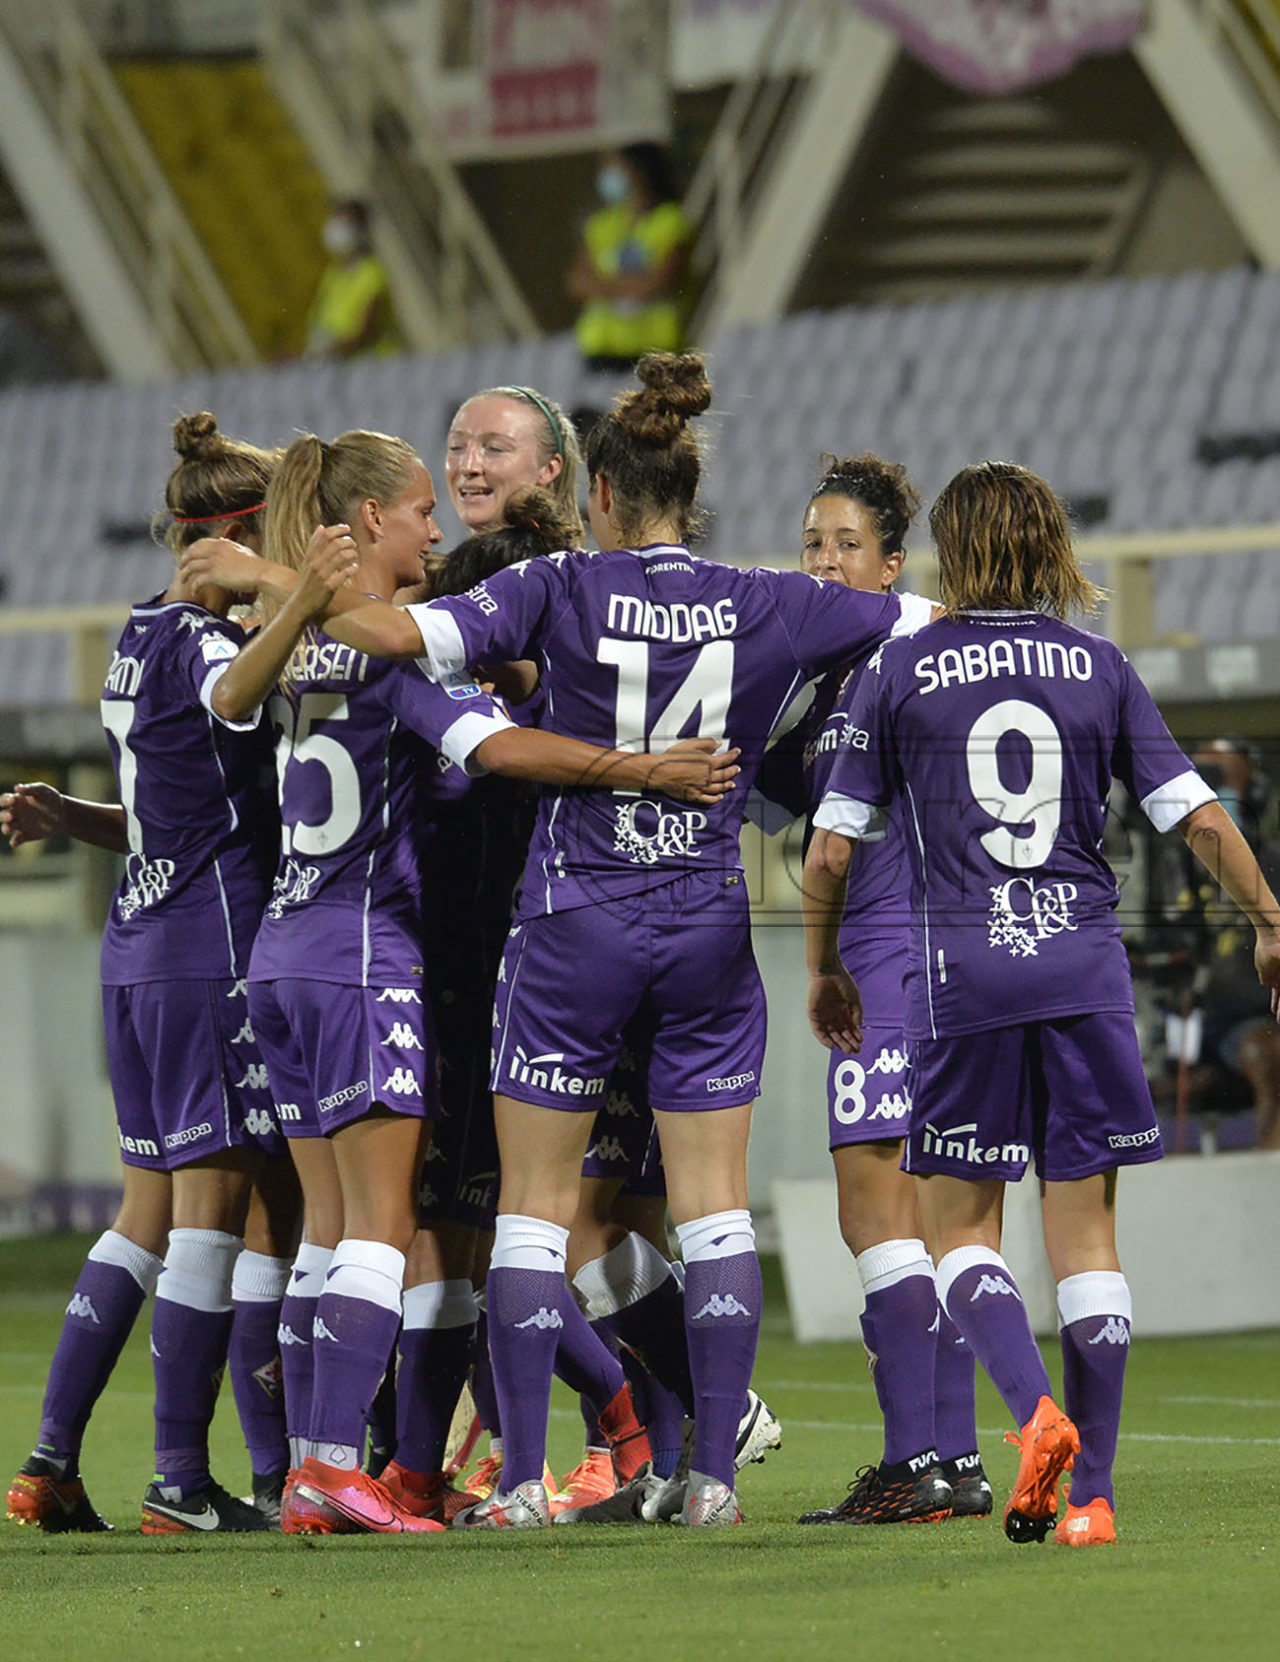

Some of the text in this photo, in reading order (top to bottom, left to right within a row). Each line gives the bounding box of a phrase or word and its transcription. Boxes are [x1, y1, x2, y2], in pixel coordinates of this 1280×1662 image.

[608, 593, 738, 643] MIDDAG
[914, 638, 1093, 695] SABATINO
[596, 637, 735, 796] 14
[966, 699, 1063, 869] 9
[318, 1080, 369, 1112] Kappa
[508, 1055, 605, 1096] linkem
[834, 1060, 866, 1125] 8
[164, 1122, 212, 1148] Kappa
[922, 1131, 1030, 1165] linkem
[1108, 1126, 1161, 1149] Kapp
